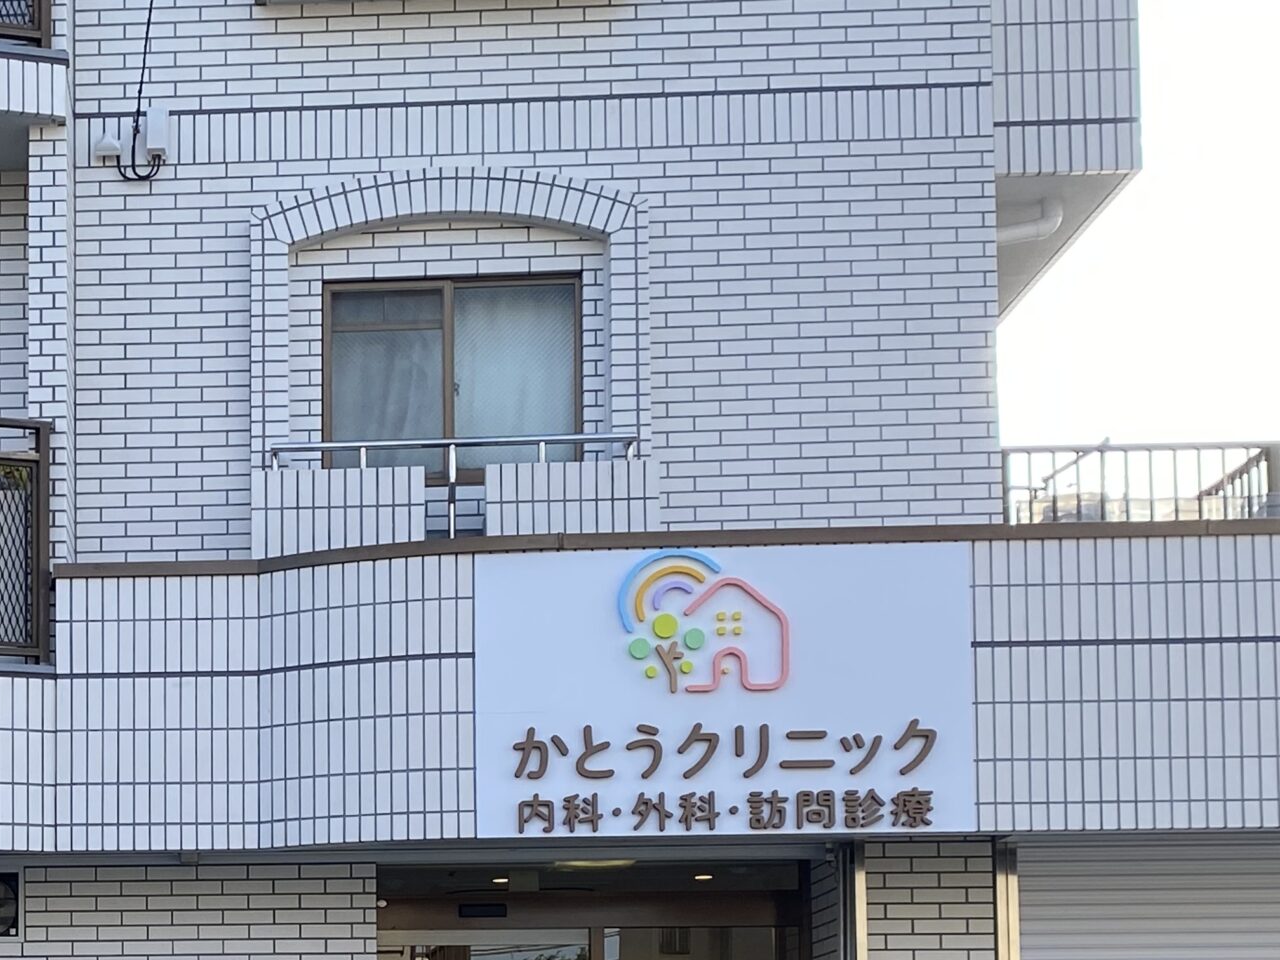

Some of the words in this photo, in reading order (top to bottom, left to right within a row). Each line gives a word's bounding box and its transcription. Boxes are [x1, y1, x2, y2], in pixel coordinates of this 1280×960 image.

[513, 718, 937, 780] かとうクリニック
[518, 786, 934, 834] 内科・外科・訪問診療
